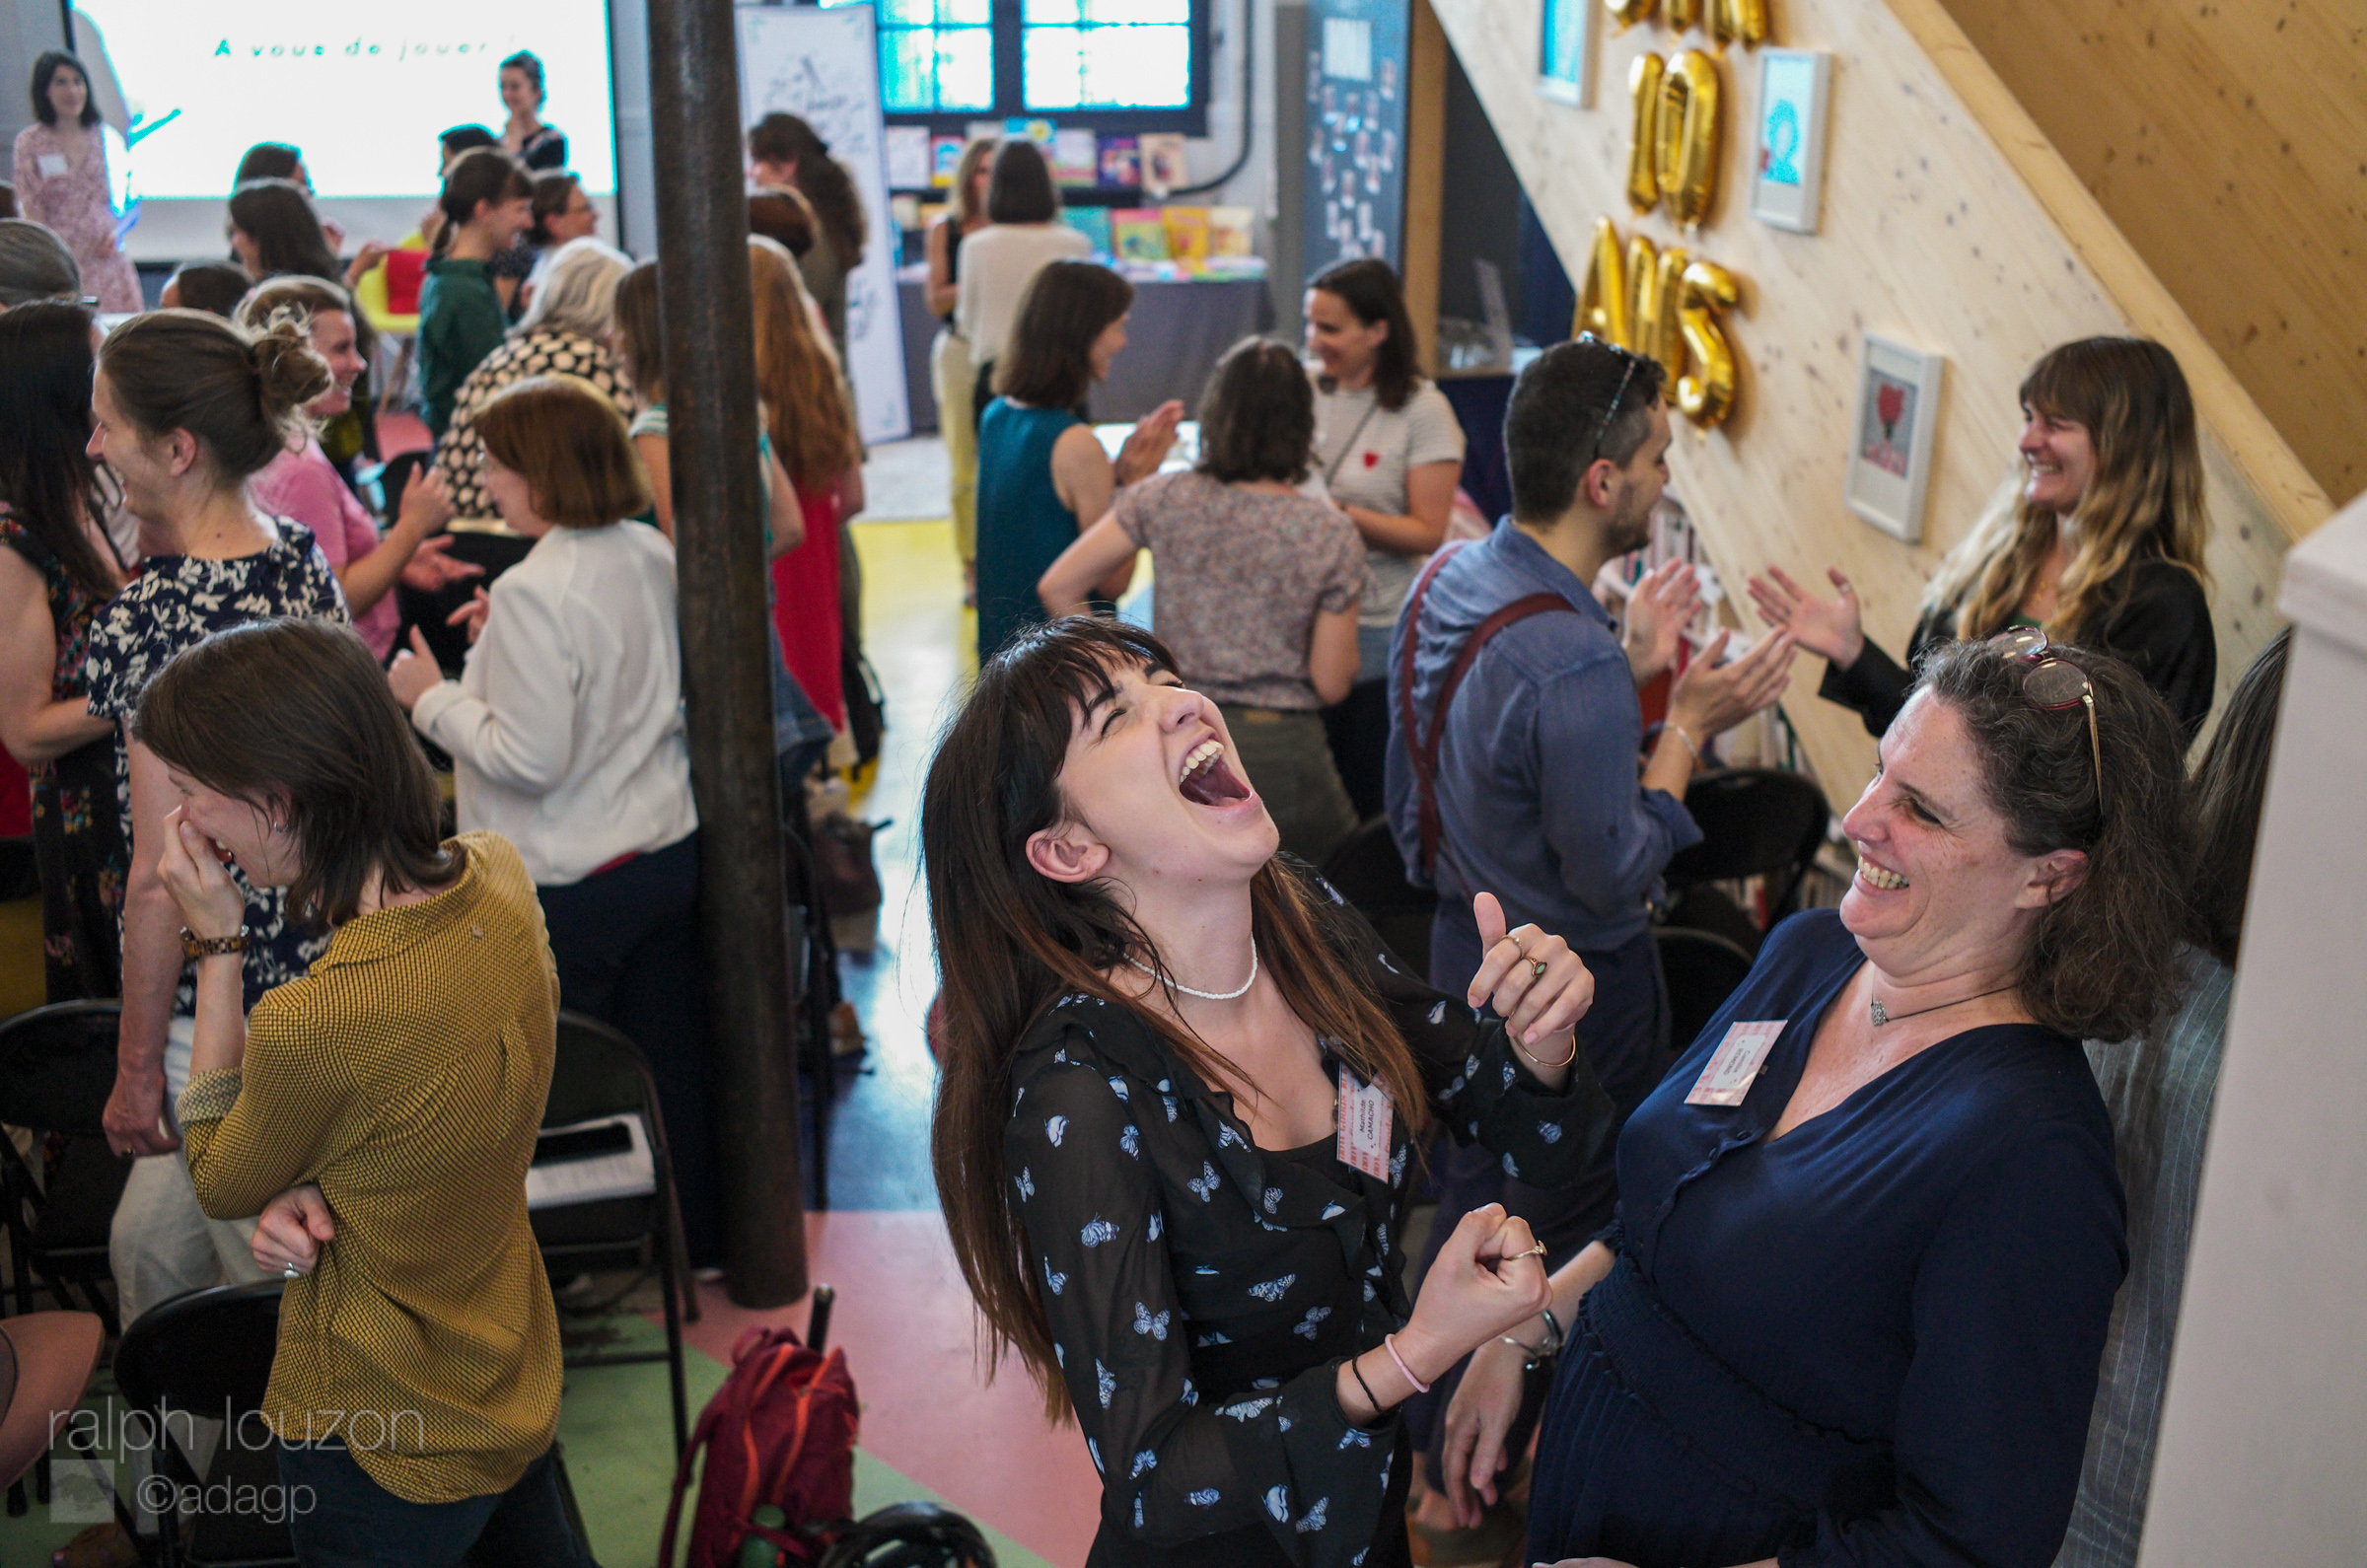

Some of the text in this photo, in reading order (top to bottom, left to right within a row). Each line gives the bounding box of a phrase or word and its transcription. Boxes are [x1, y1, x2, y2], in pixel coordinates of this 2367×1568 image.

[213, 37, 231, 56] A
[251, 43, 325, 57] vous
[344, 35, 382, 56] de
[398, 36, 487, 62] jouer
[1627, 49, 1718, 225] 10
